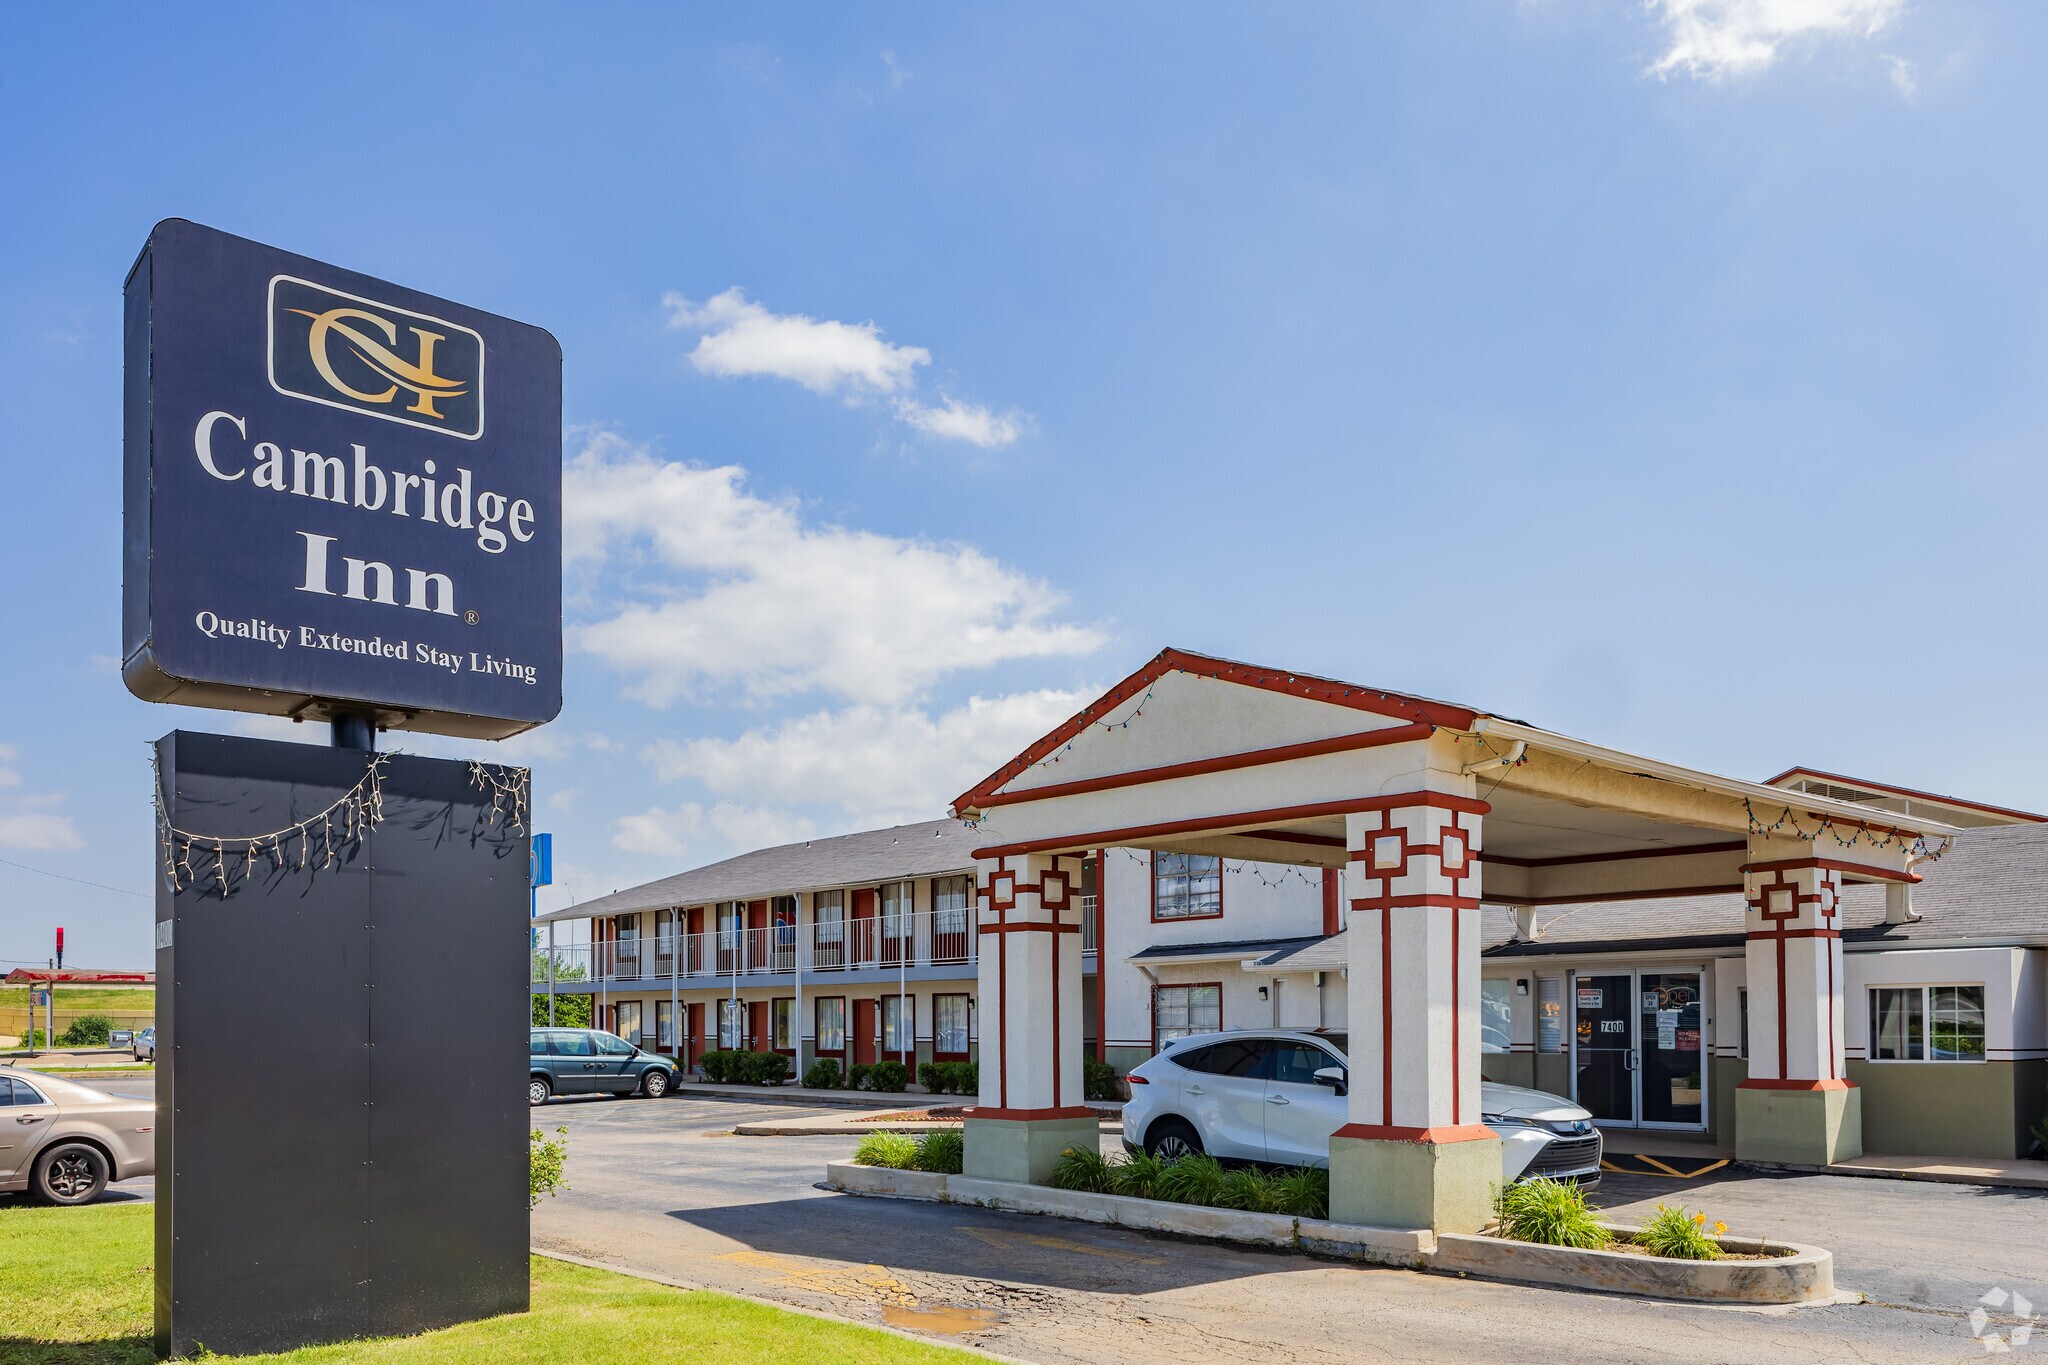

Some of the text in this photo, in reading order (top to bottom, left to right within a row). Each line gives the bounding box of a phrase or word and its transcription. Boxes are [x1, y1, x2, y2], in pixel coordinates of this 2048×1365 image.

[194, 410, 536, 554] Cambridge
[295, 530, 459, 618] Inn
[195, 610, 537, 686] Quality Extended Stay Living
[1601, 1022, 1623, 1032] 7400
